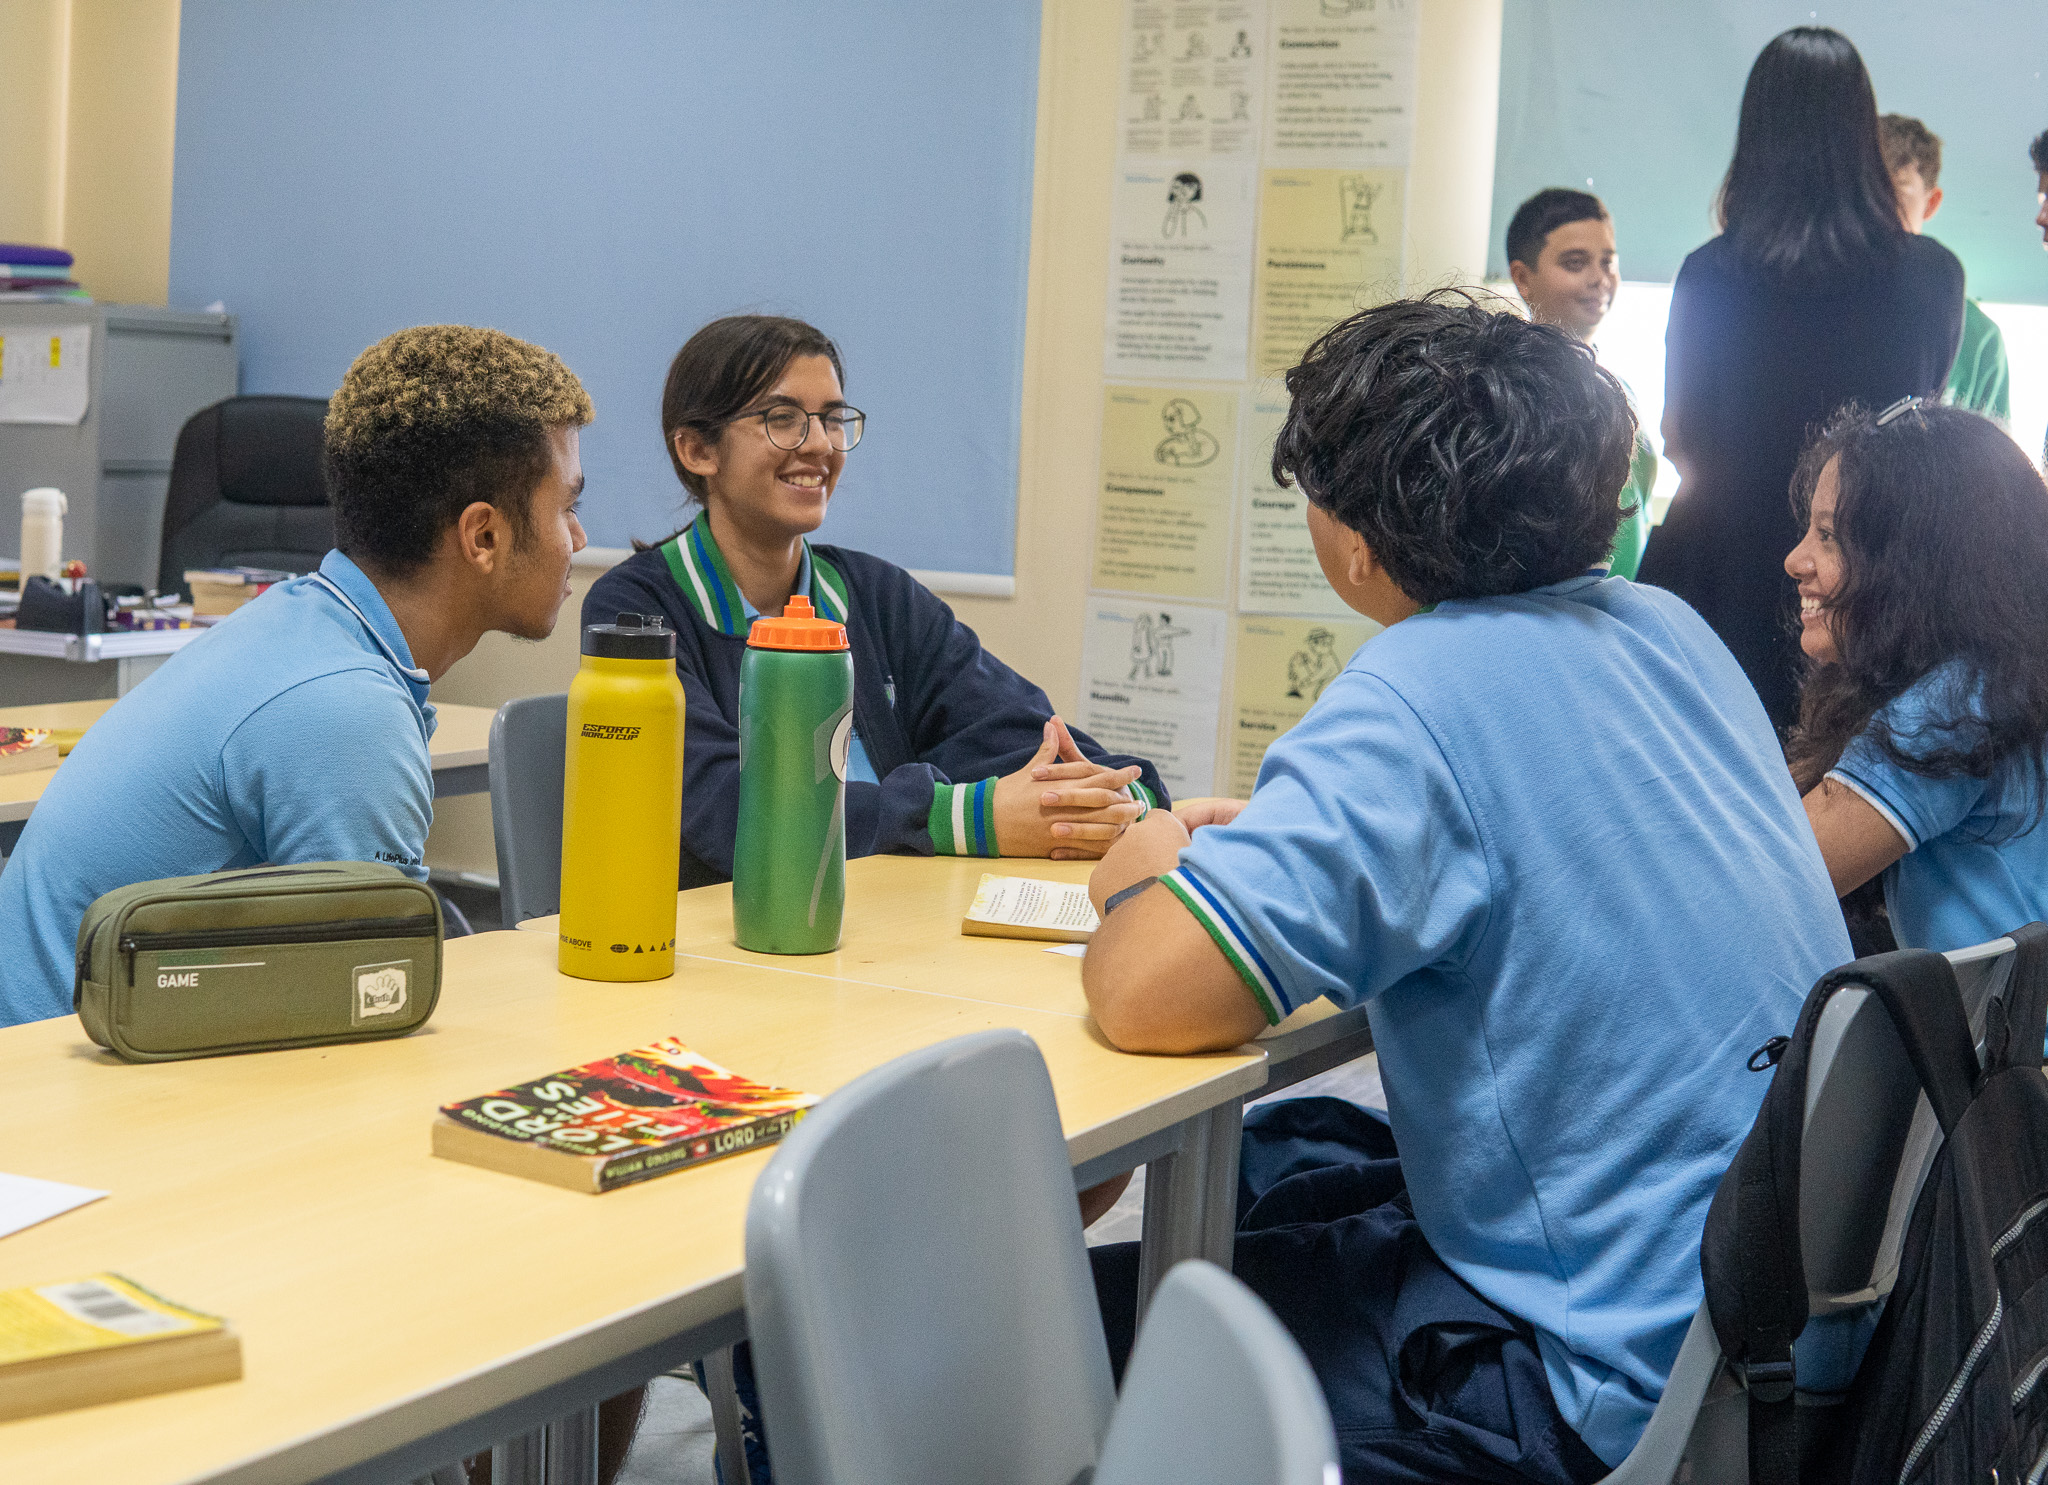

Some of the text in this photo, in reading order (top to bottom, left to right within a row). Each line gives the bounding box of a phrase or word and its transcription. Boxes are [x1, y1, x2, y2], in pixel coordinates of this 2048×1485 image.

[1251, 498, 1296, 512] Courage
[1090, 691, 1131, 706] Humility
[582, 723, 642, 735] ESPORTS
[1239, 718, 1277, 733] Service
[581, 730, 639, 741] WORLD CUP
[569, 938, 592, 948] ABOVE
[157, 973, 200, 988] GAME
[532, 1081, 688, 1138] FLIES
[481, 1100, 634, 1152] LORD
[714, 1126, 756, 1153] LORD
